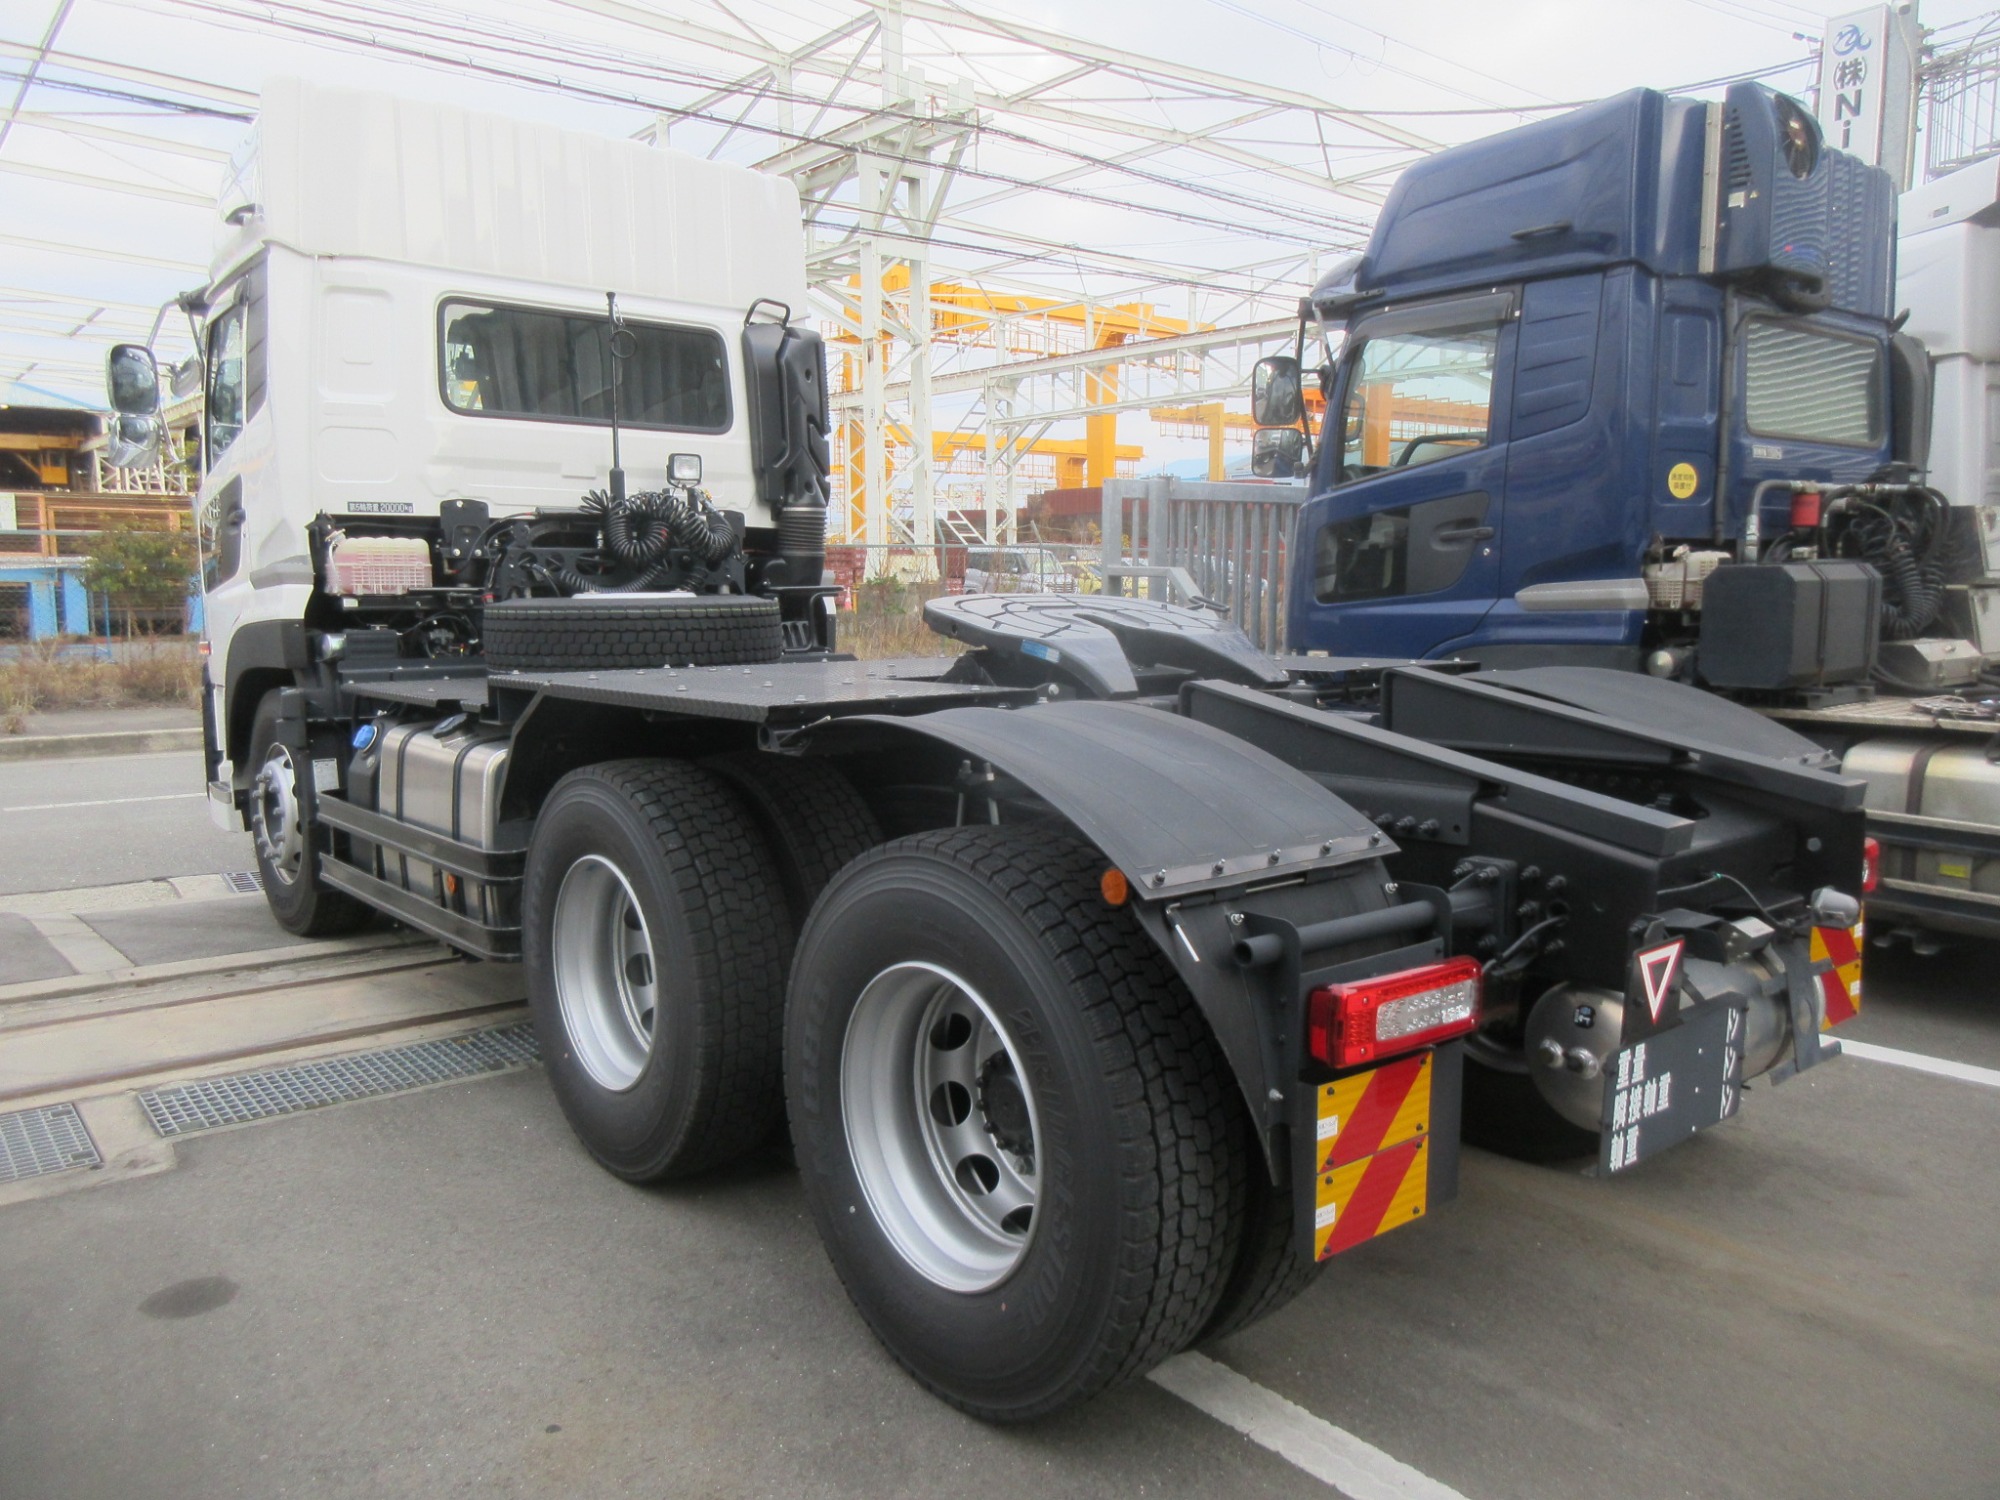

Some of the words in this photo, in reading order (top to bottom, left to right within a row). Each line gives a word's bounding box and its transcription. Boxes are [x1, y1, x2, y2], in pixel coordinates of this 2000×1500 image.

[1616, 1043, 1646, 1090] 重量
[1613, 1071, 1671, 1131] 隣接軸重
[1609, 1124, 1639, 1172] 軸重
